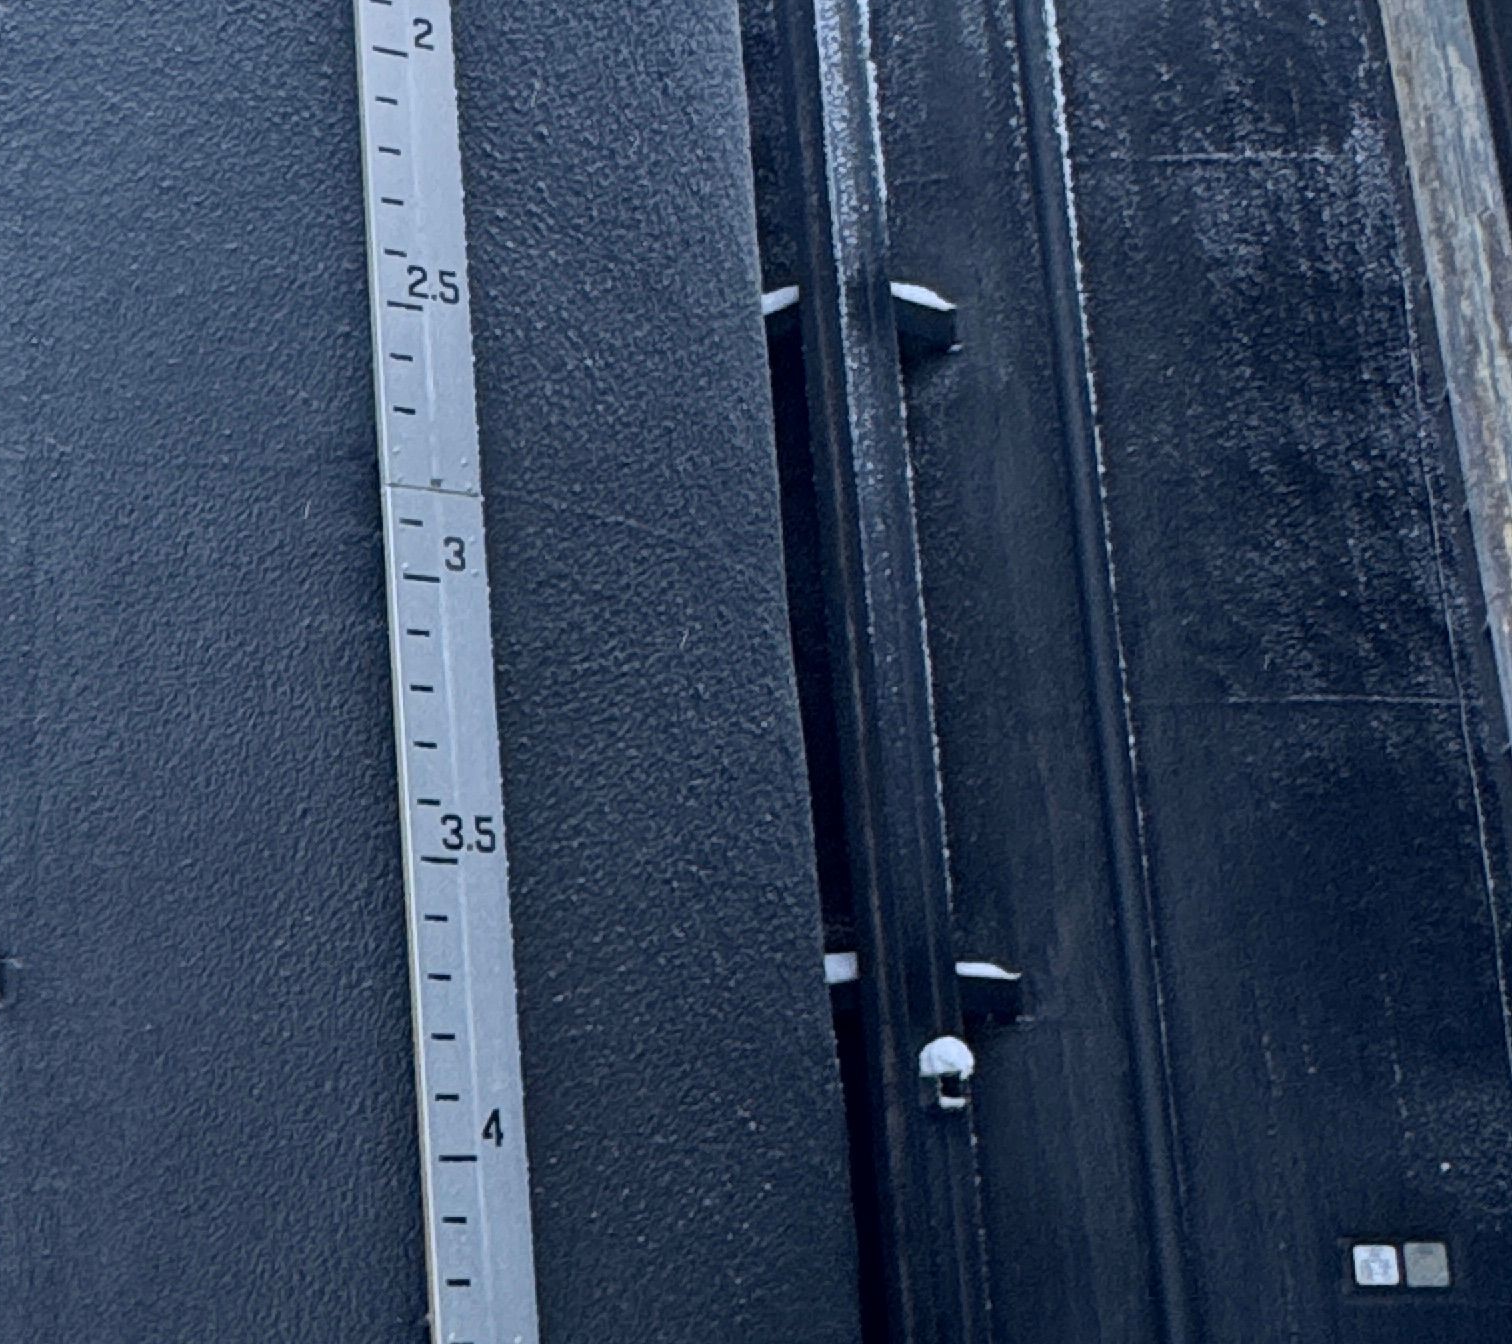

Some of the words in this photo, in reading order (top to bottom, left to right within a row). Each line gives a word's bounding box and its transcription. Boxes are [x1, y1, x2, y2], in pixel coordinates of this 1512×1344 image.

[413, 18, 434, 50] 2
[407, 265, 459, 304] 2.5
[444, 537, 466, 571] 3
[442, 814, 497, 853] 3.5
[482, 1109, 504, 1146] 4
